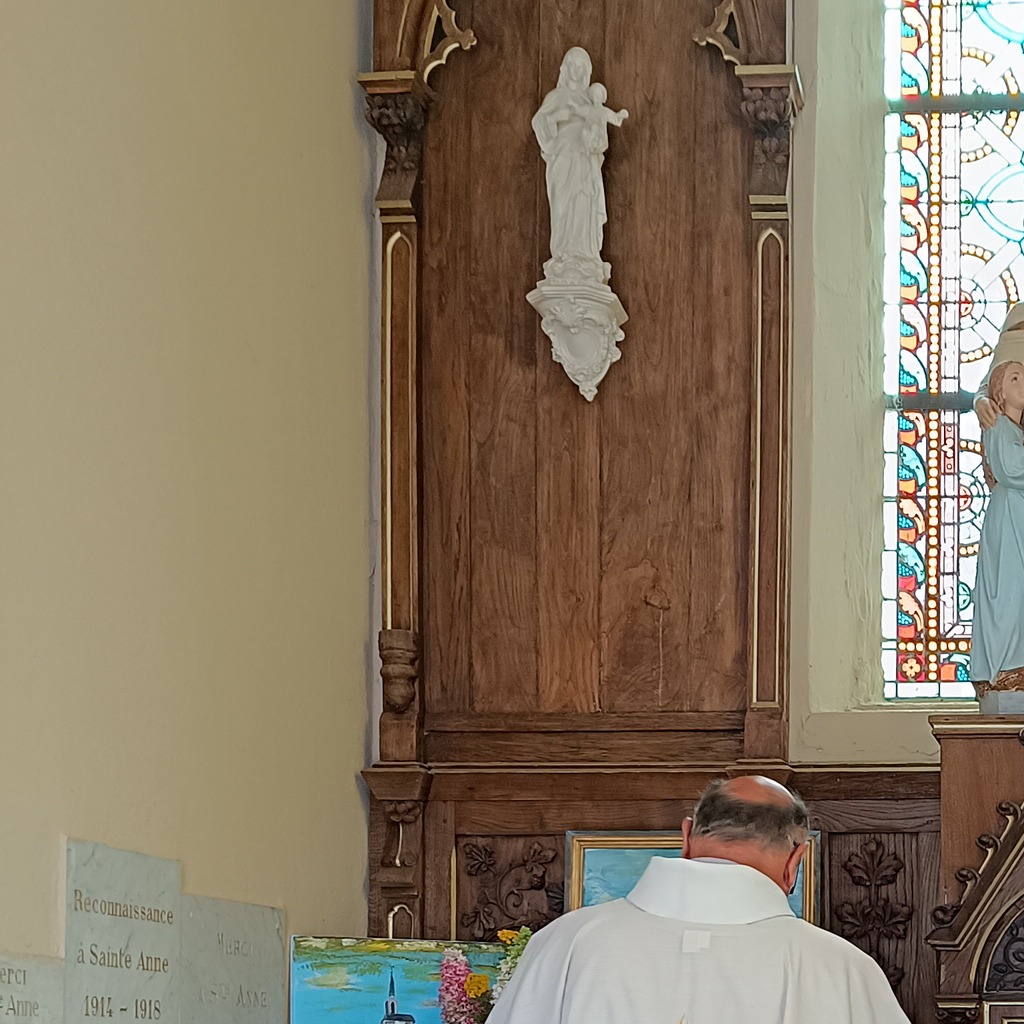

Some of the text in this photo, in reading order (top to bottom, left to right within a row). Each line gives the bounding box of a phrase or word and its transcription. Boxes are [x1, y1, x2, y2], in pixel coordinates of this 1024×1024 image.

[73, 888, 174, 925] Reconnaissance
[77, 942, 169, 973] à Sainte Anne
[0, 967, 26, 985] erci
[5, 995, 39, 1017] Anne
[84, 995, 113, 1018] 1914
[134, 998, 161, 1020] 1918
